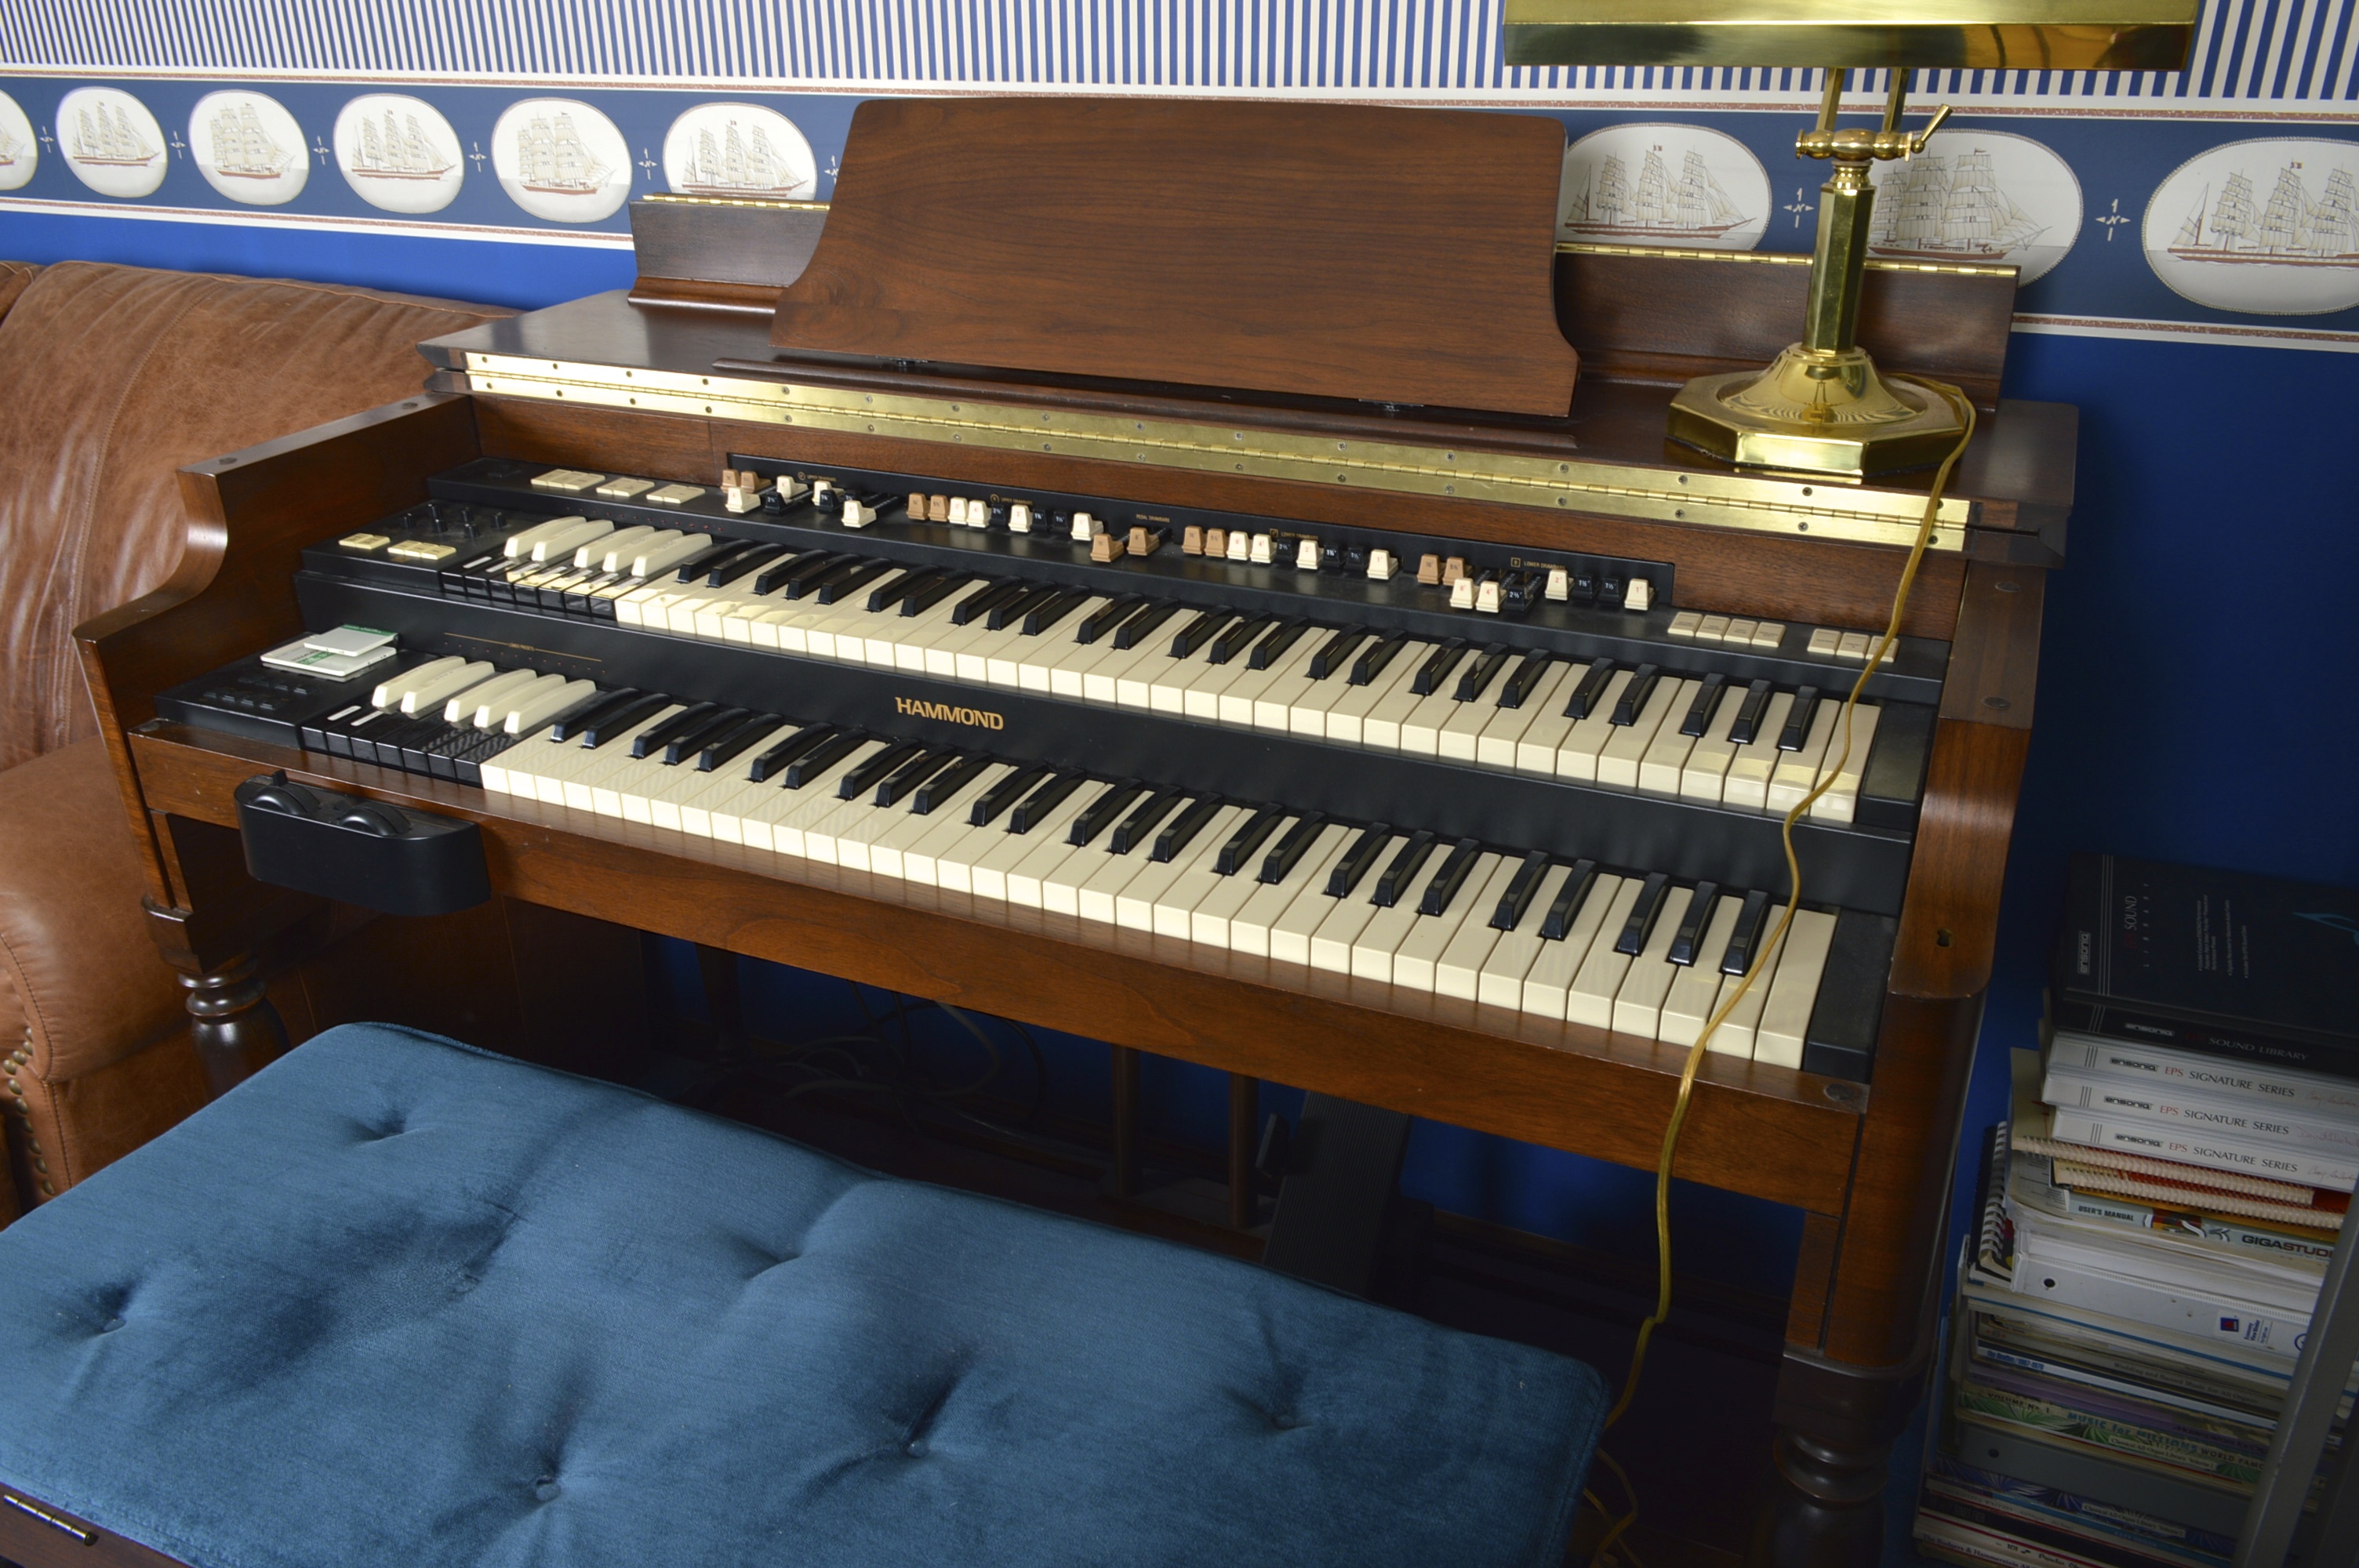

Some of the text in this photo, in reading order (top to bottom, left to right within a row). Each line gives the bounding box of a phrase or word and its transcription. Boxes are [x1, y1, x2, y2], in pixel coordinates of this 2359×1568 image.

[895, 697, 1004, 731] HAMMOND
[2125, 895, 2138, 931] SOUND
[2125, 1022, 2175, 1036] ensoniq
[2208, 1036, 2255, 1052] SOUND
[2259, 1046, 2310, 1062] LIBRARY
[2110, 1057, 2295, 1098] ensoniq EPS SIGNATURE SERIES
[2104, 1095, 2290, 1135] ensoniq EPS SIGNATURE SERIES
[2114, 1133, 2298, 1173] ensoniq EPS SIGNATURE SERIES
[2078, 1206, 2135, 1221] USER'S MANUAL
[2114, 1363, 2143, 1375] Wedding
[2160, 1374, 2183, 1385] Sacred
[2185, 1380, 2205, 1391] Music
[1987, 1392, 2023, 1406] VOLUME
[2067, 1411, 2106, 1429] MUSIC
[2113, 1424, 2132, 1435] for
[2136, 1430, 2198, 1453] MILLIONS
[2201, 1447, 2235, 1461] WORLD
[1923, 1534, 1936, 1543] The
[1937, 1537, 1964, 1552] Rodgers
[1973, 1548, 2019, 1568] Hammerstein
